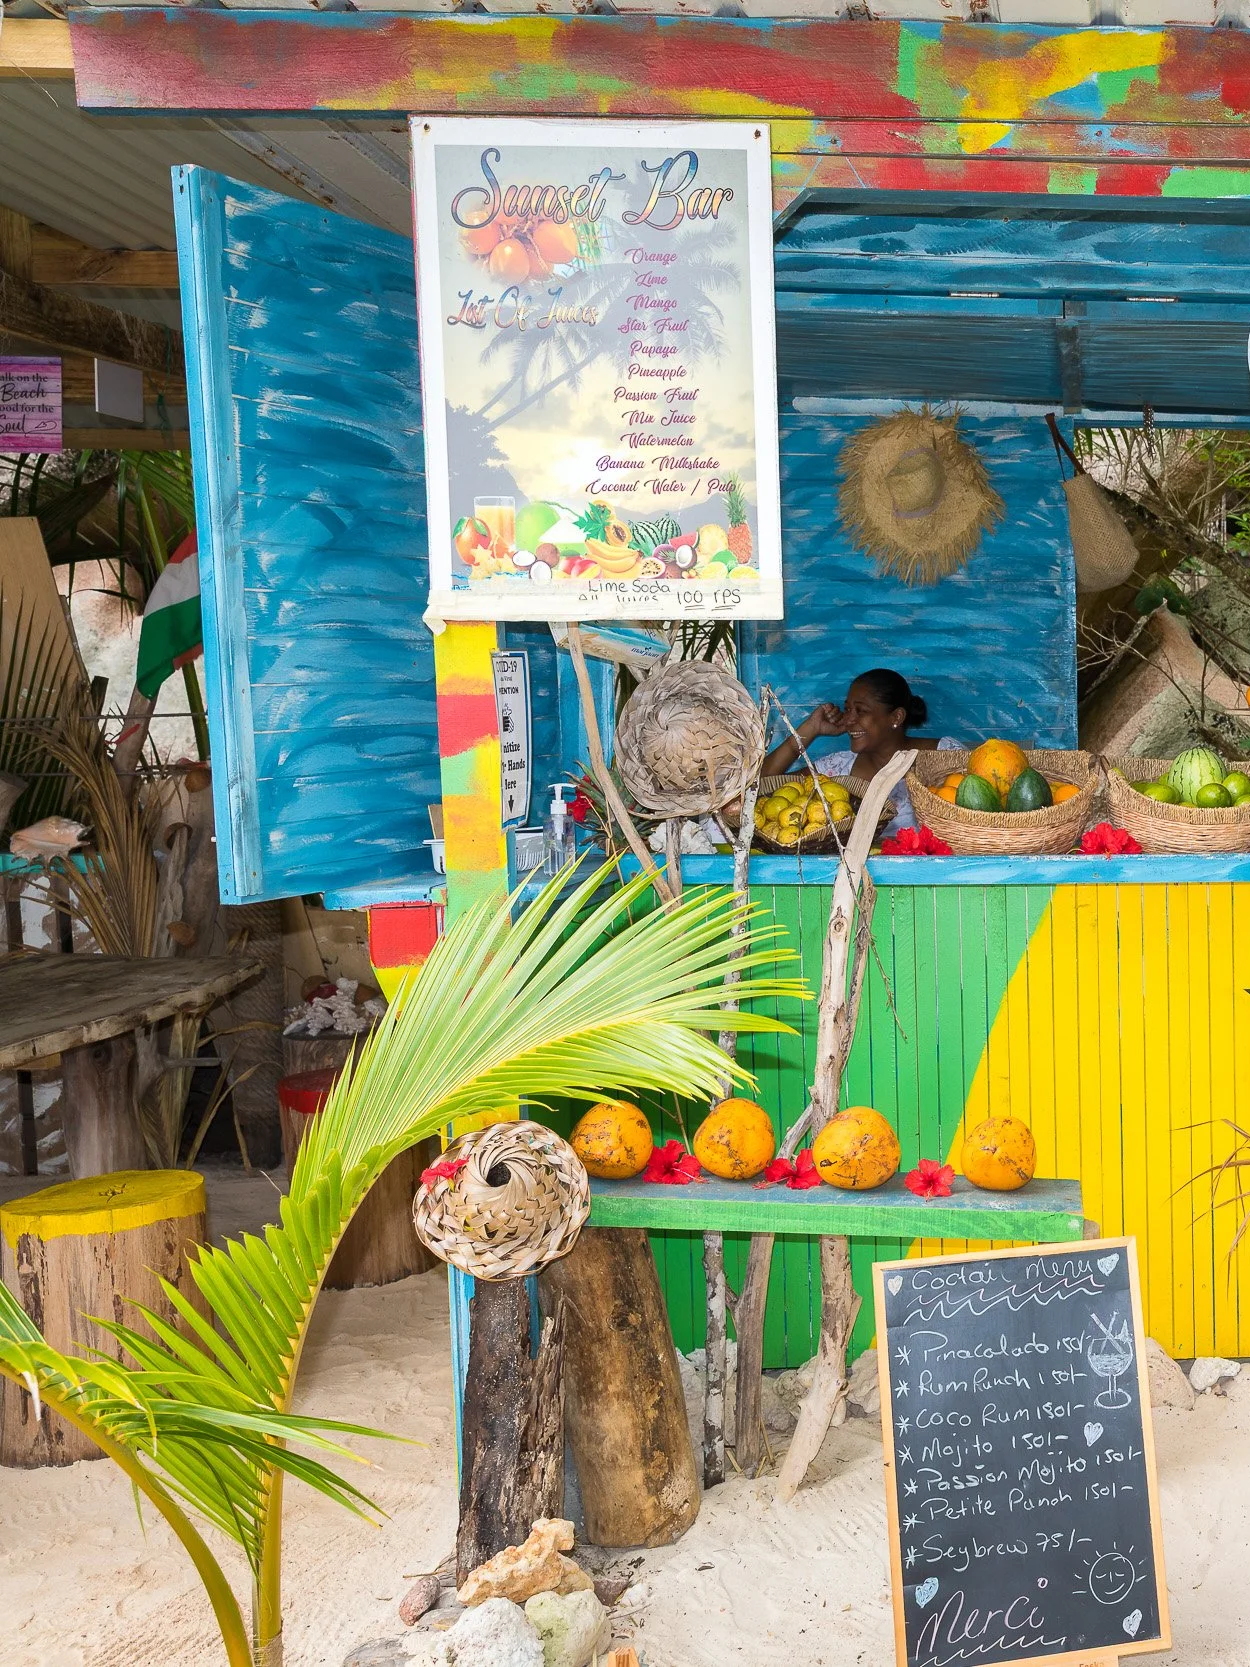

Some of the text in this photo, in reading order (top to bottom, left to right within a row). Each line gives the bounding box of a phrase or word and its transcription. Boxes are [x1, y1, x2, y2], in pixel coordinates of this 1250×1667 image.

[451, 148, 734, 231] Sunset Bar
[624, 247, 678, 266] Orange
[634, 269, 668, 287] Lime
[447, 285, 598, 332] List Of Juices
[625, 294, 678, 312] Mango
[617, 317, 690, 334] Star Fruit
[630, 340, 678, 359] Papaya
[32, 373, 48, 382] the
[628, 363, 687, 381] Pineapple
[0, 383, 46, 402] Beach
[613, 386, 700, 404] Passion Fruit
[21, 403, 38, 412] for
[38, 403, 54, 413] the
[621, 410, 696, 427] Mix Juice
[620, 432, 695, 449] Watermelon
[596, 455, 720, 472] Banana Milkshake
[585, 478, 639, 496] Coconut
[643, 478, 687, 495] Water
[707, 478, 736, 495] Pulp
[588, 579, 671, 594] Lime Soda
[676, 590, 704, 605] 100
[508, 758, 525, 771] Hands
[918, 1369, 967, 1397] Rum
[982, 1403, 1030, 1426] Rum
[921, 1433, 993, 1467] Mojito
[917, 1465, 1008, 1491] Passion
[1018, 1451, 1087, 1485] Mojito
[920, 1498, 996, 1521] Petite
[922, 1533, 1028, 1571] Seybrew
